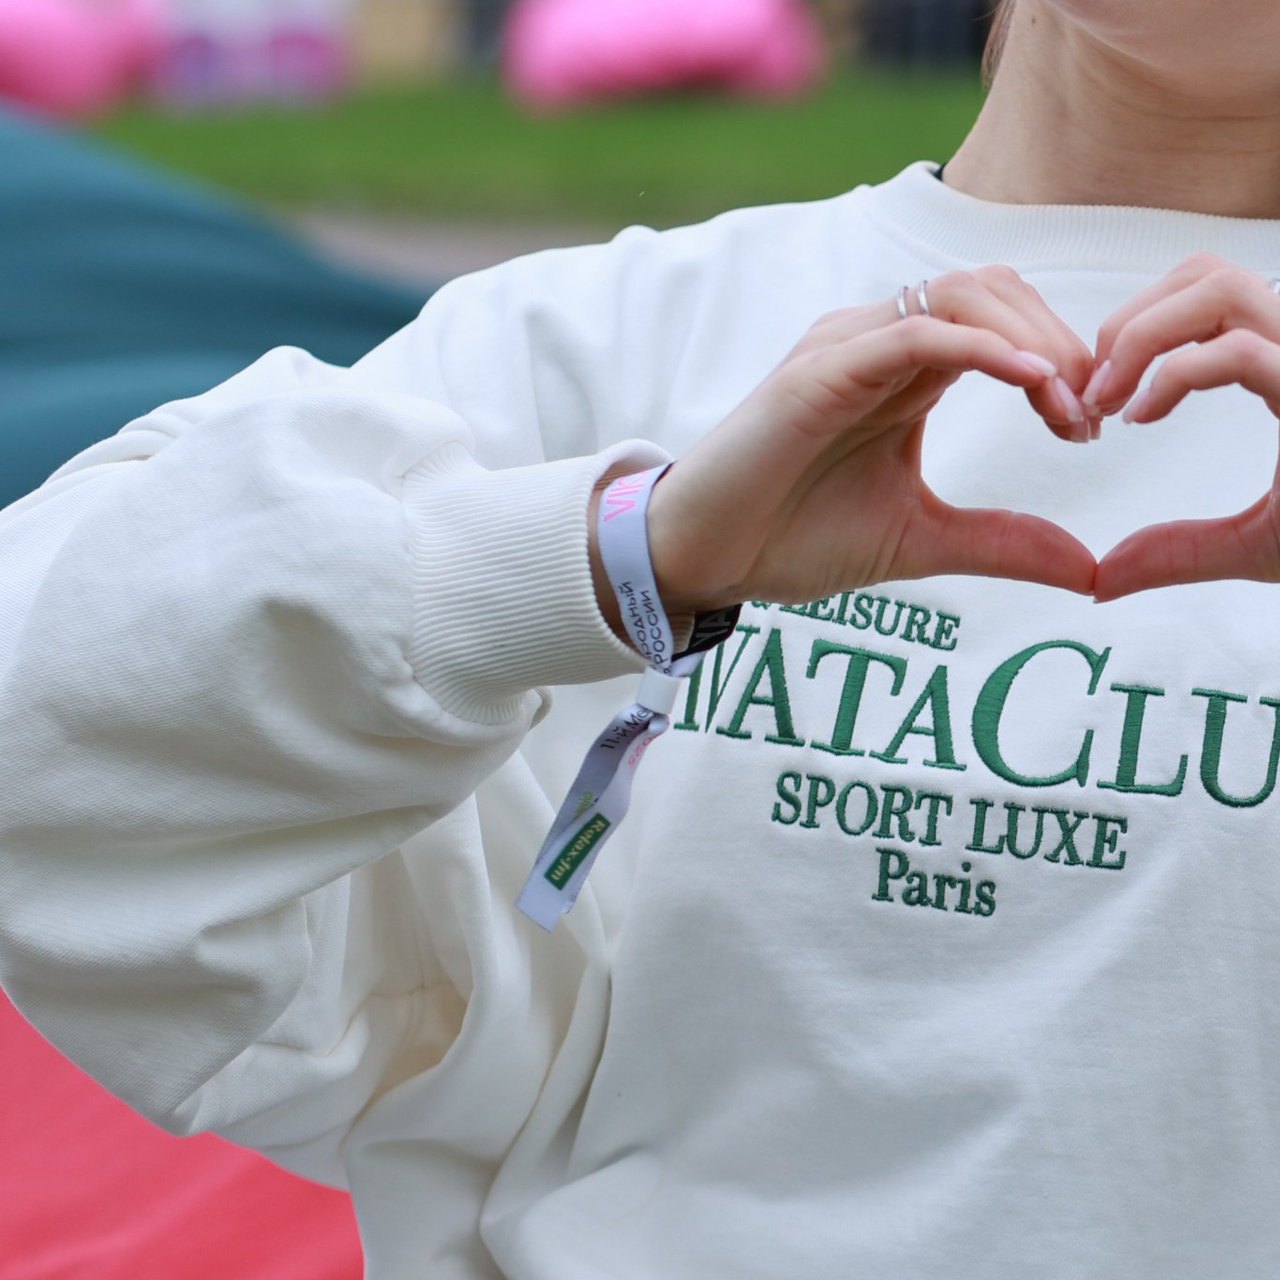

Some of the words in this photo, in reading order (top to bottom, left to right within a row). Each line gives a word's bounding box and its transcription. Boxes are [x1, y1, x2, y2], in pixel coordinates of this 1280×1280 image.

[771, 771, 953, 846] SPORT
[964, 797, 1128, 870] LUXE
[871, 847, 997, 917] Paris
